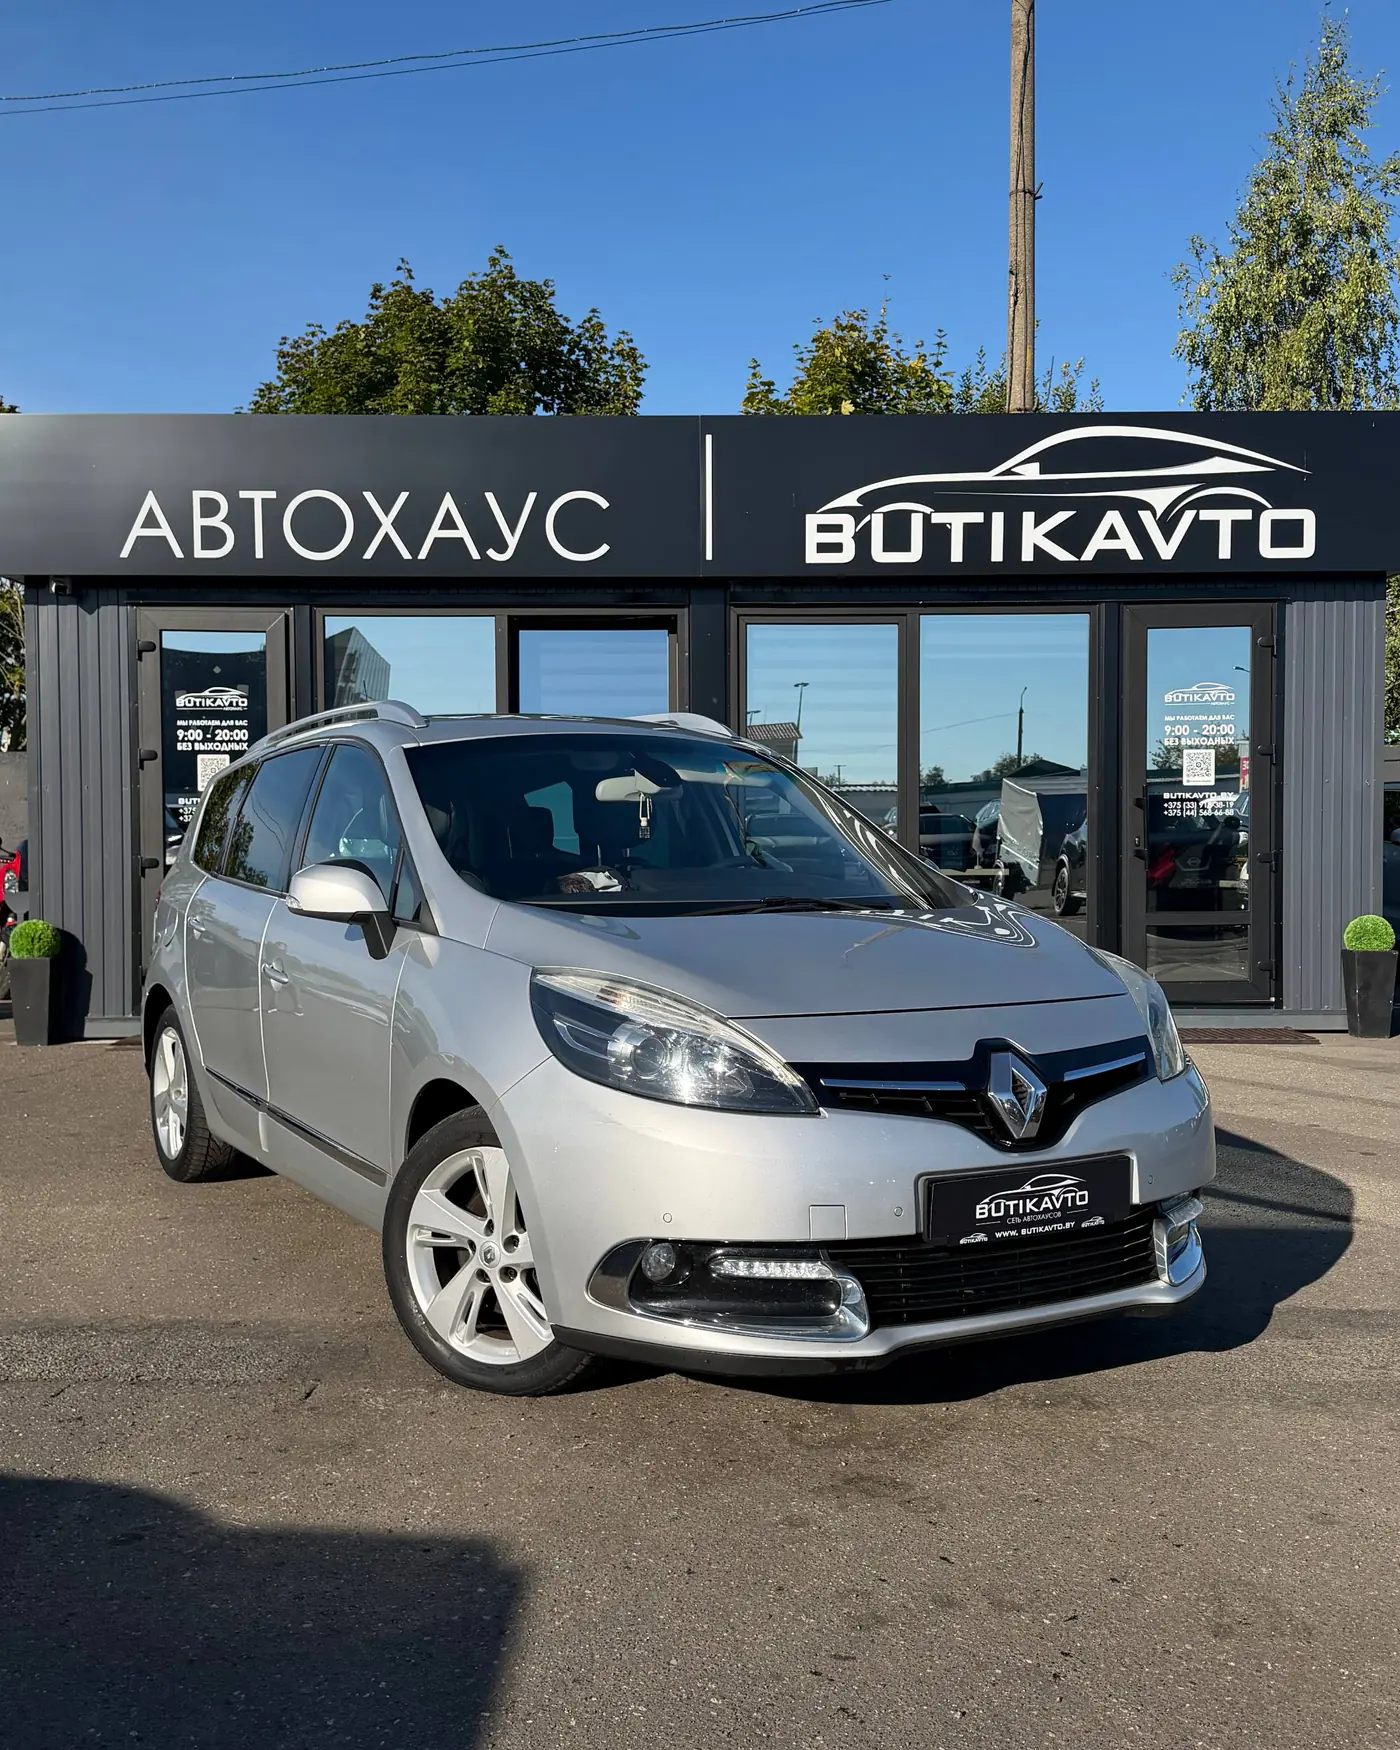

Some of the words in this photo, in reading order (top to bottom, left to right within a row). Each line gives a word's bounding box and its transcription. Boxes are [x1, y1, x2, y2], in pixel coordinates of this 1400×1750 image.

[119, 488, 611, 562] АВТОХАУС
[804, 507, 1317, 565] BUTIKAVTO
[176, 698, 248, 707] BUTIKAVTO
[1164, 693, 1235, 702] BUTIKAVTO
[176, 729, 203, 741] 9:00
[214, 729, 249, 741] 20:00
[1164, 725, 1190, 735] 9:00
[1202, 724, 1235, 735] 20:00
[177, 742, 192, 751] БЕЗ
[194, 742, 248, 751] ВЫХОДНЫХ
[1164, 738, 1179, 746] БЕЗ
[1181, 737, 1235, 746] ВЫХОДНЫХ
[1183, 802, 1197, 810] (33)
[1163, 809, 1182, 817] +375
[1183, 809, 1197, 818] (44)
[975, 1190, 1089, 1219] BUTIKAVTO
[1006, 1216, 1022, 1225] СЕТЬ
[1022, 1211, 1062, 1222] АВТОХАУСОВ
[1021, 1221, 1076, 1236] BUTIKAVTO.BY
